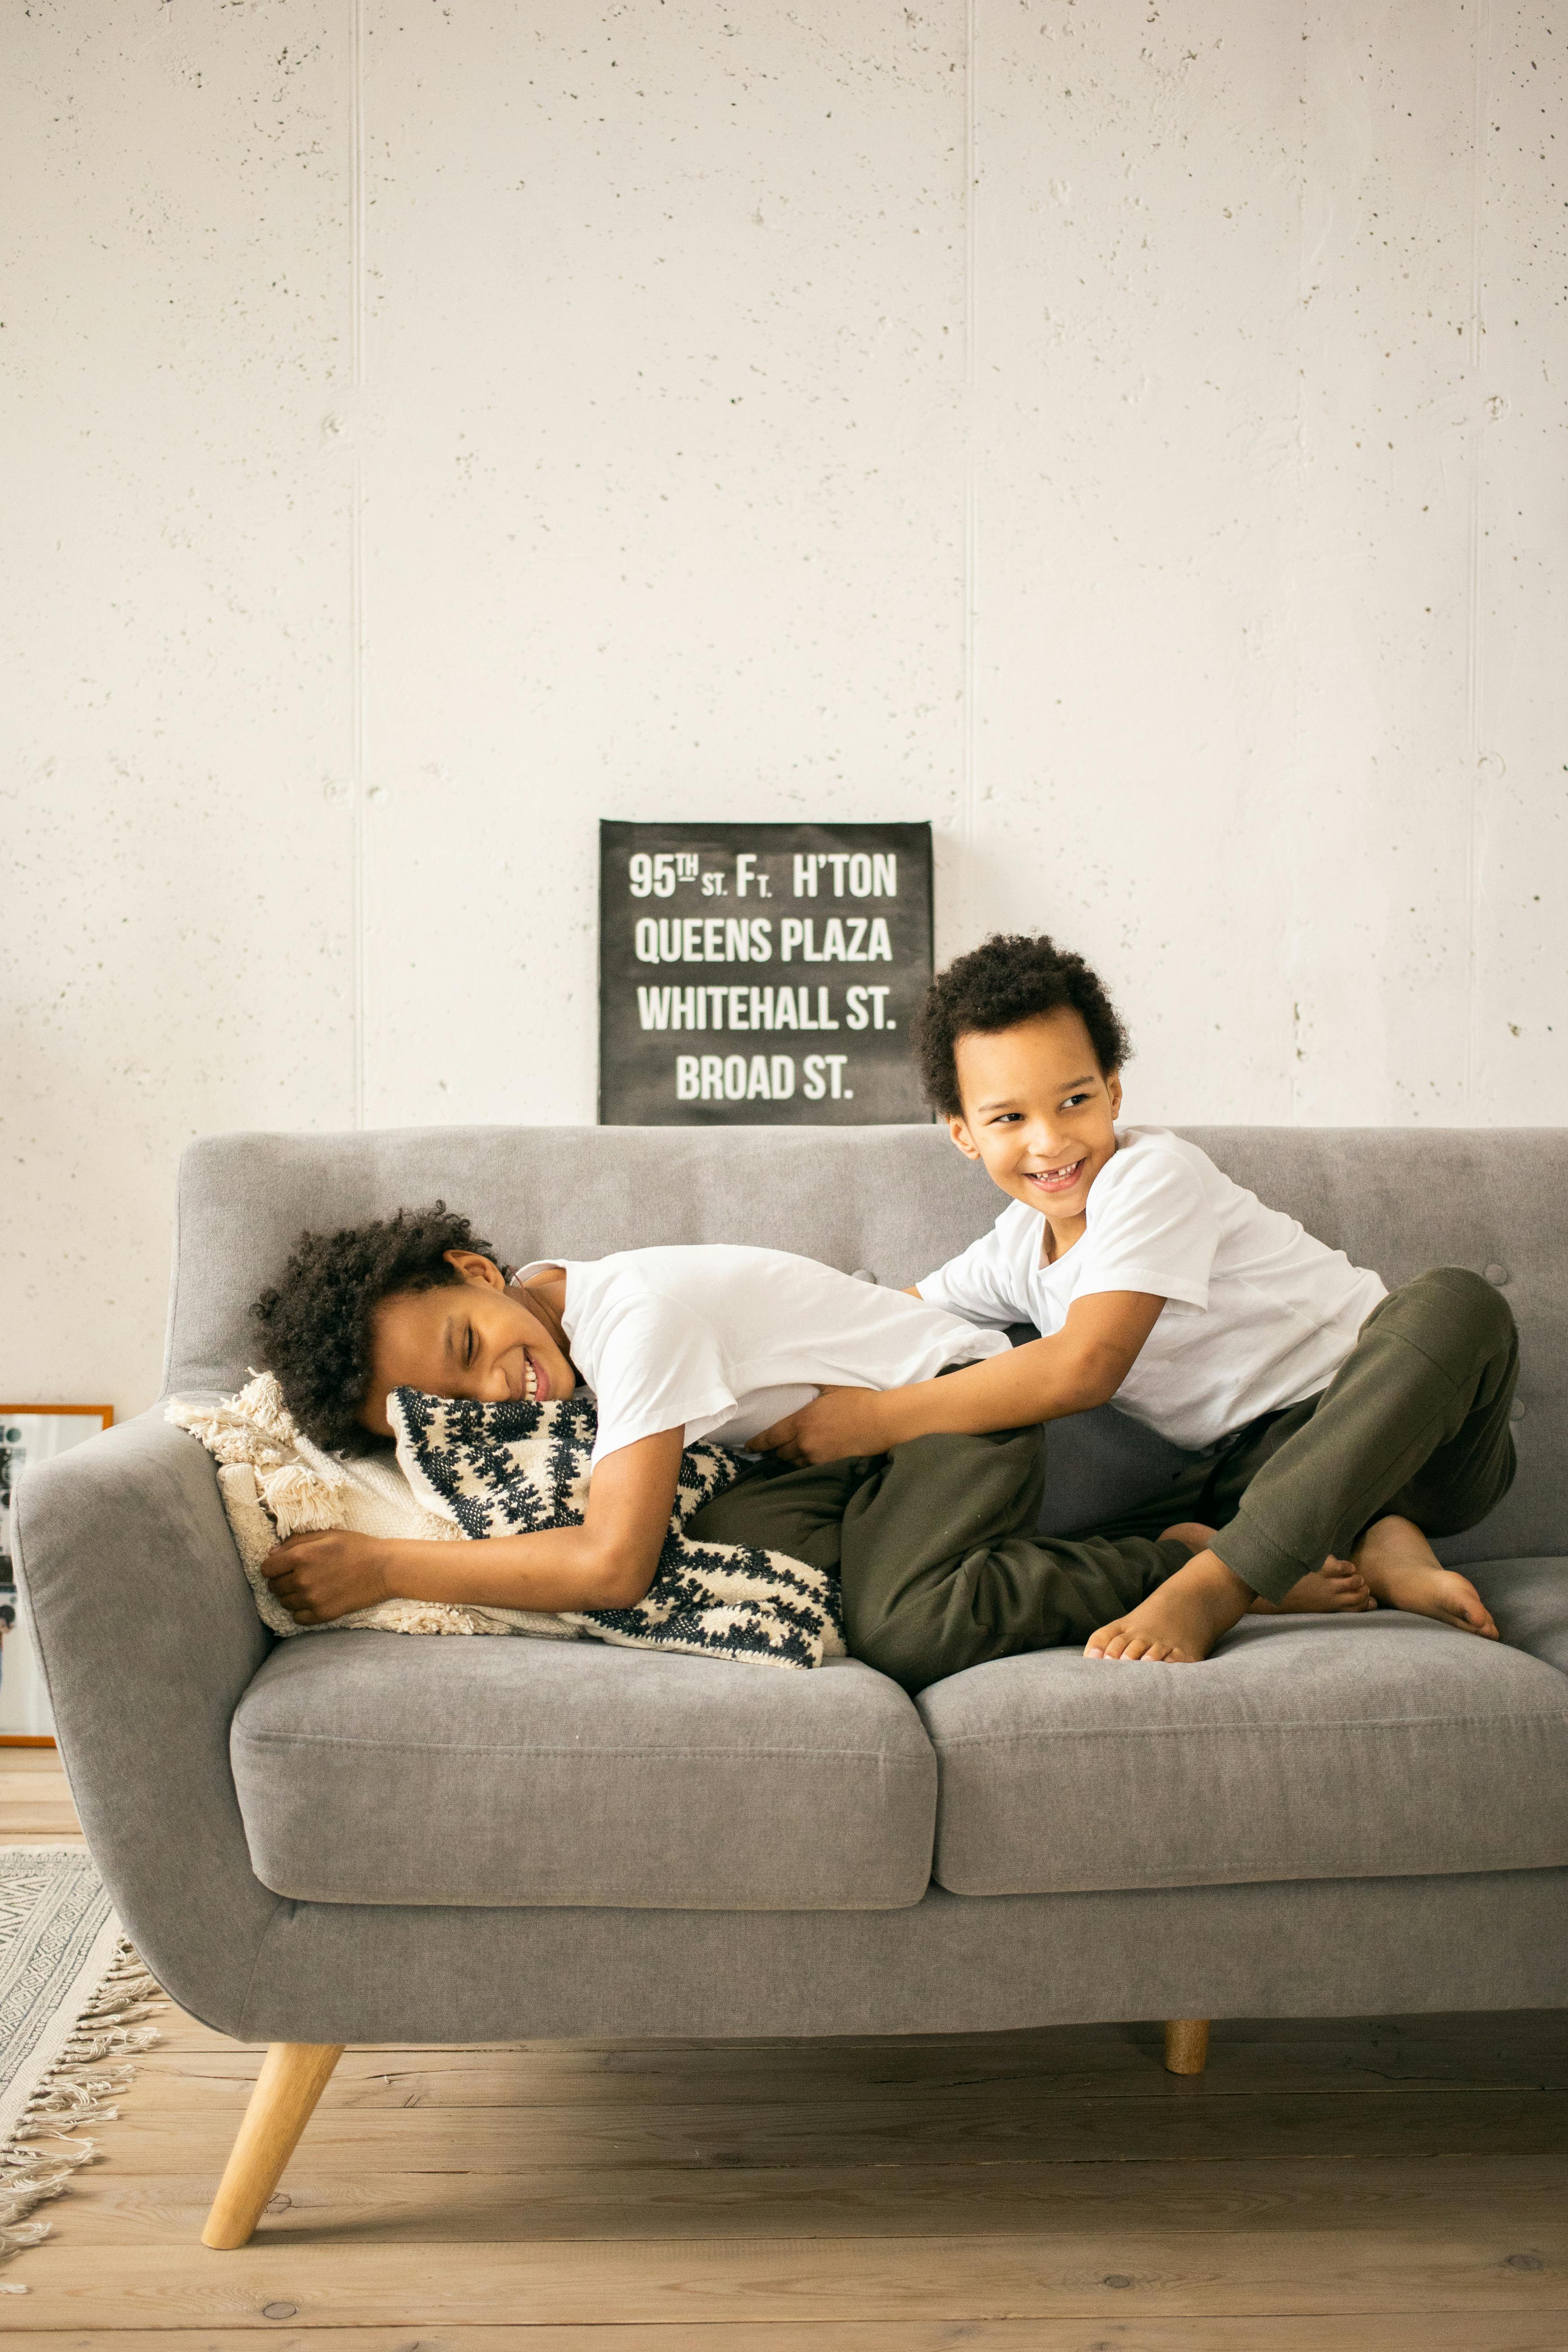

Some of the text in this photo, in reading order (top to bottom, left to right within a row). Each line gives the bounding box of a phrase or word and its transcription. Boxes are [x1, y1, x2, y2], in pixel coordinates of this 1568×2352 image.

[701, 872, 728, 897] ST.
[635, 916, 893, 964] QUEENS PLAZA
[637, 985, 897, 1031] WHITEHALL ST.
[675, 1054, 854, 1101] BROAD ST.
